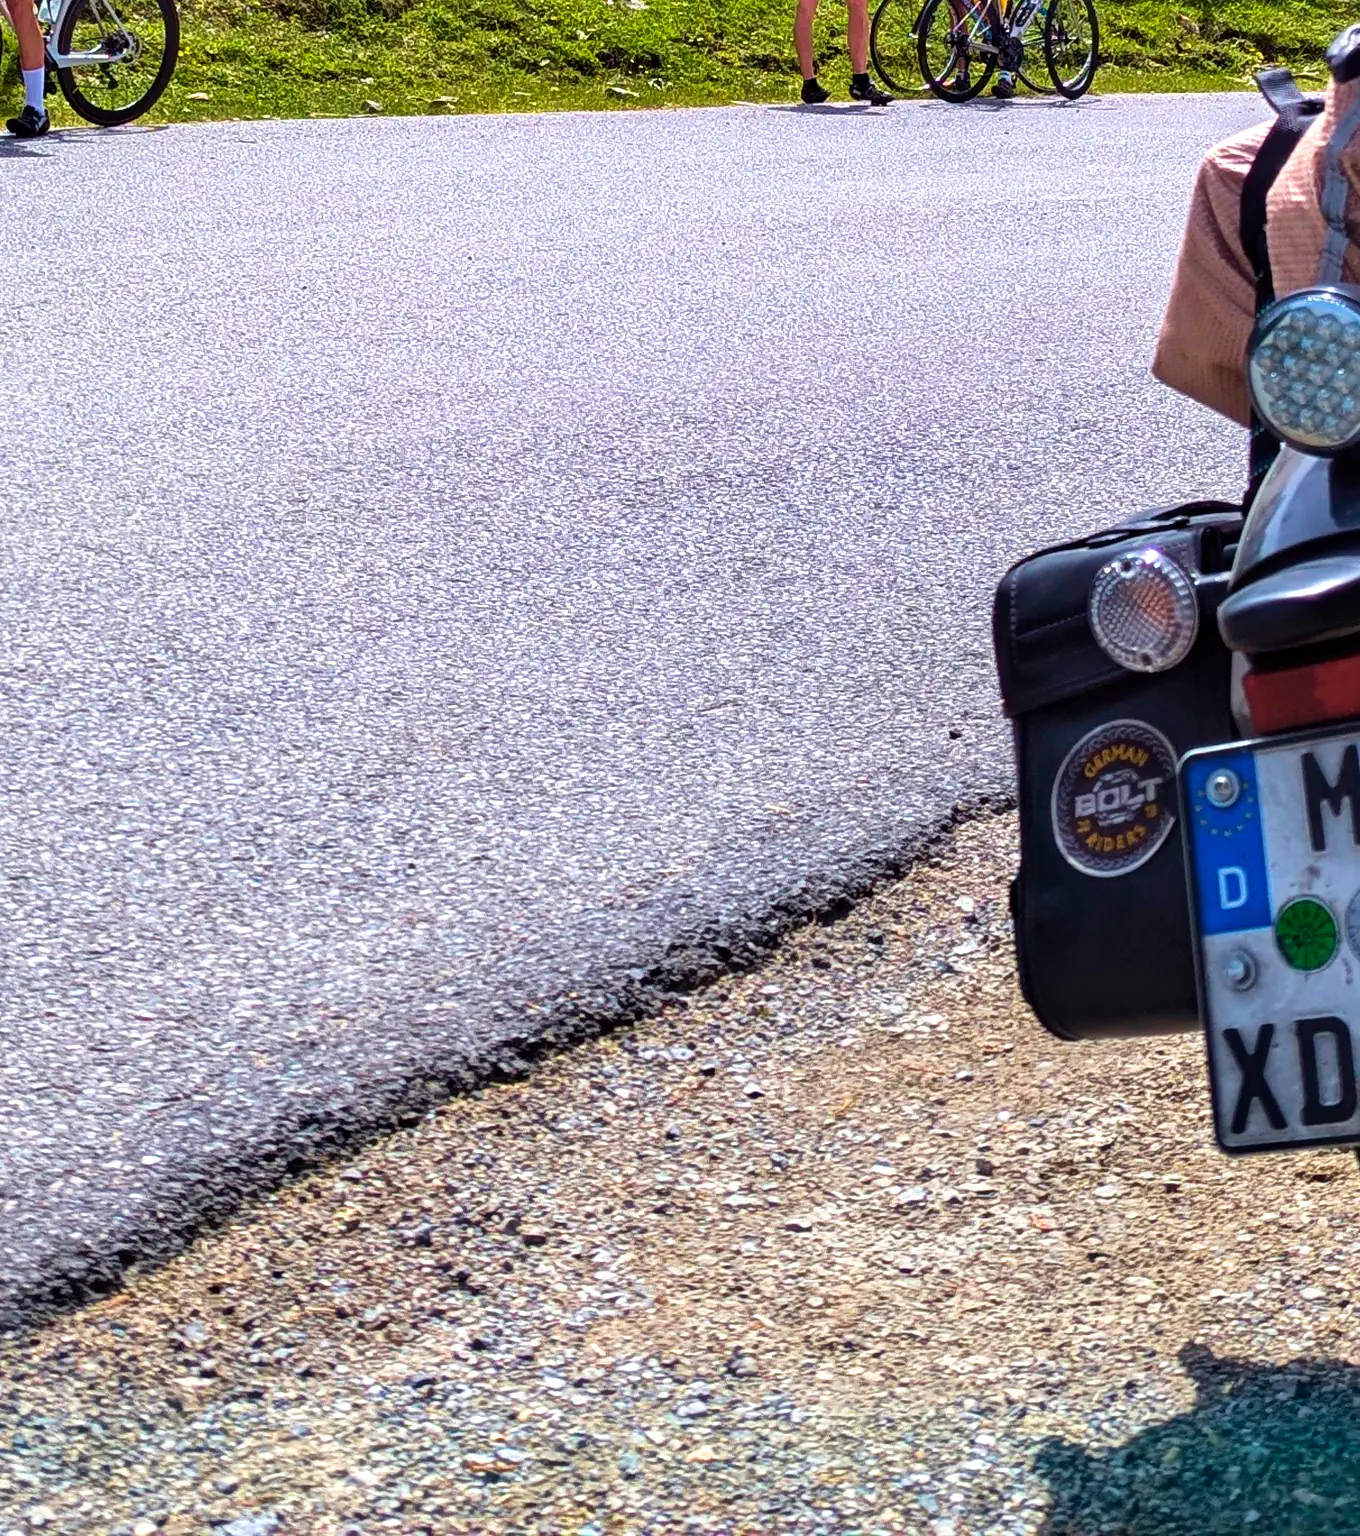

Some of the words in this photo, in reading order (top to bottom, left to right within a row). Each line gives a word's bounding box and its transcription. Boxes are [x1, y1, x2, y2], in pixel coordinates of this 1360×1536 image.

[1084, 744, 1150, 779] GERMAN
[1218, 866, 1248, 910] D
[1222, 1015, 1359, 1135] XD
